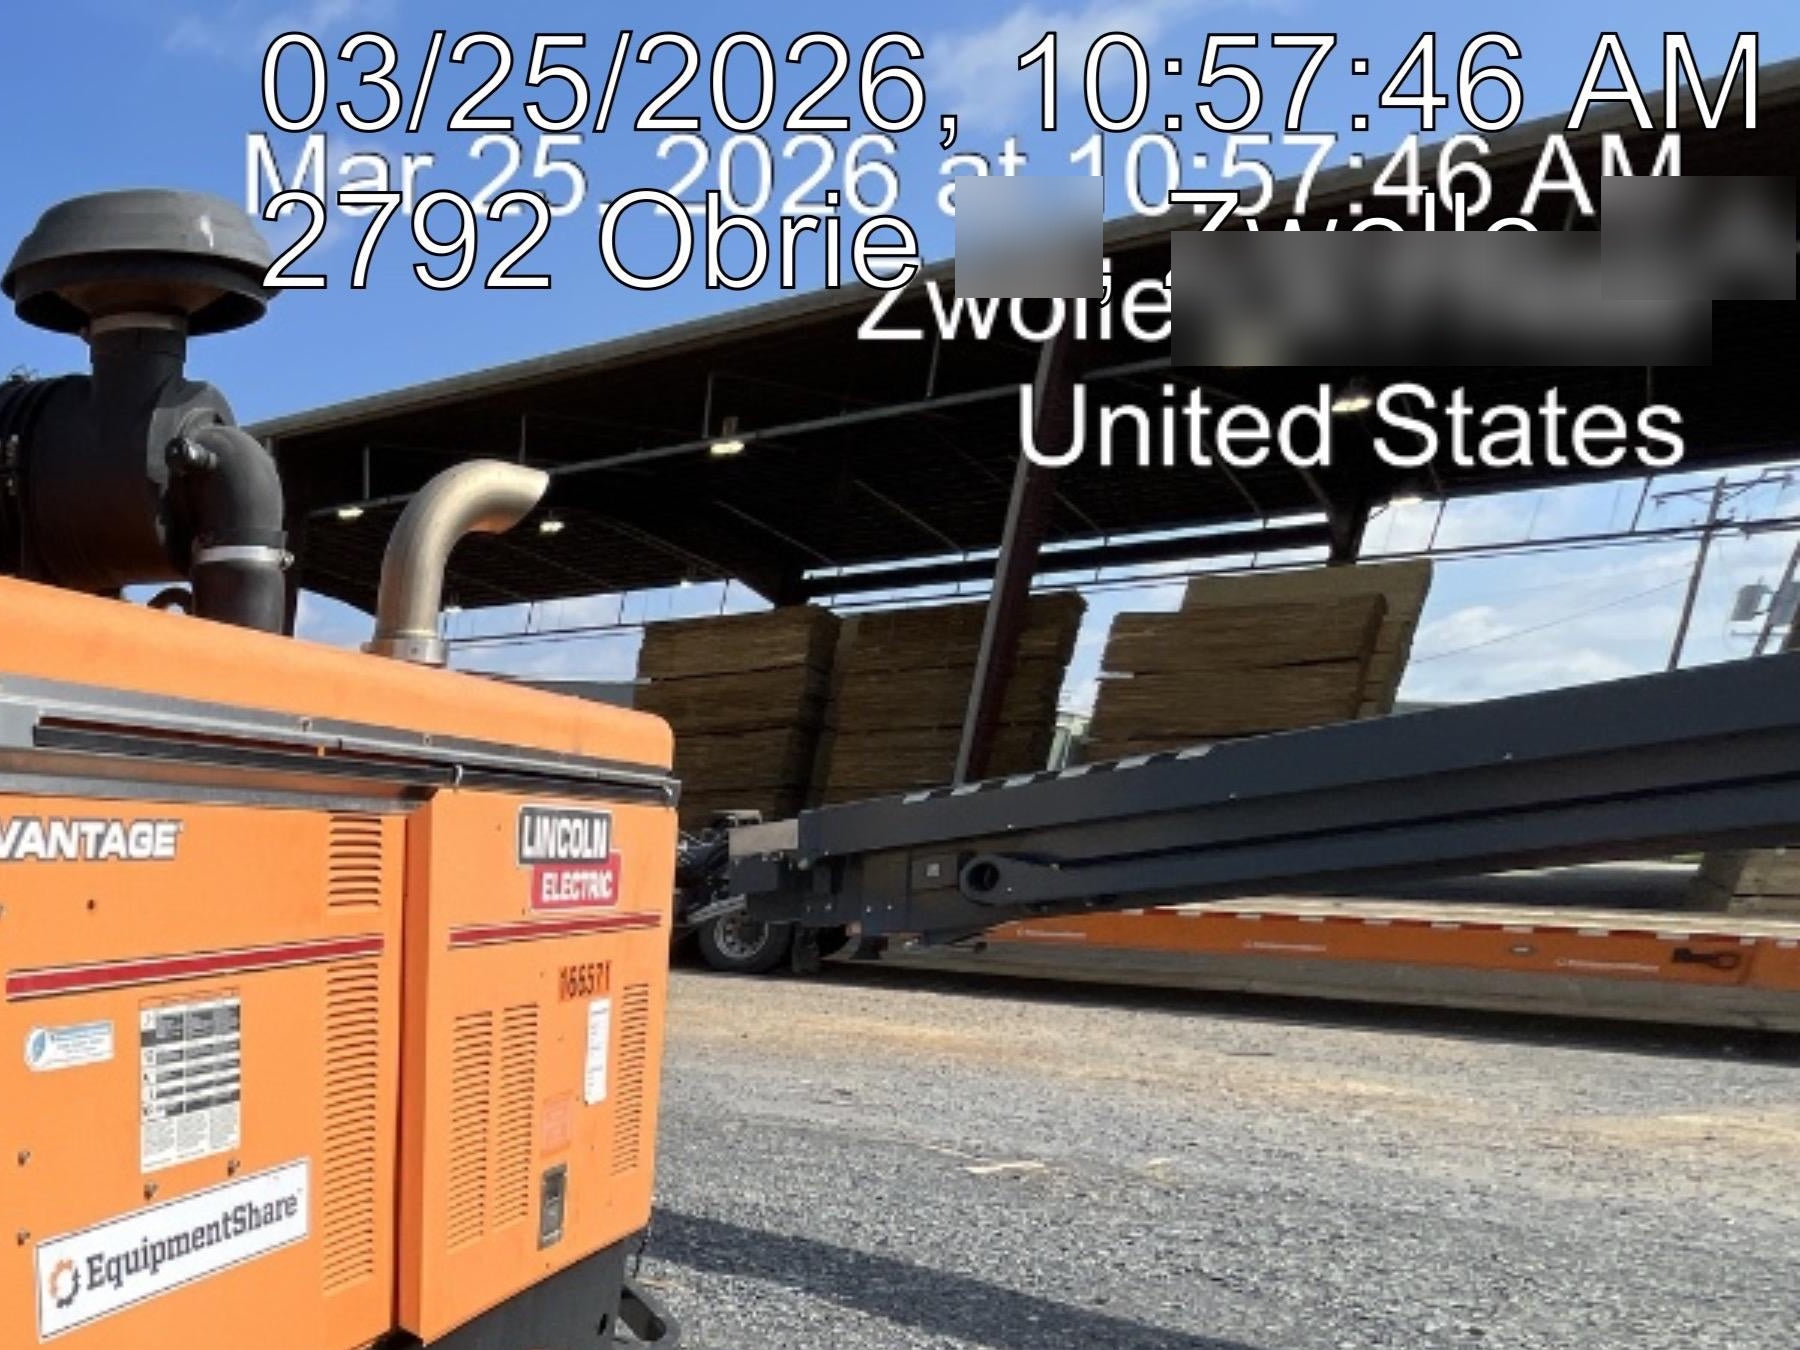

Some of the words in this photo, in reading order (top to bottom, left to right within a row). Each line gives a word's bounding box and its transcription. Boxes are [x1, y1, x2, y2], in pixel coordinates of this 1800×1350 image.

[522, 815, 608, 860] LINCOLN
[541, 869, 613, 903] ELECTRIC
[86, 1196, 299, 1291] EquipmentShare
